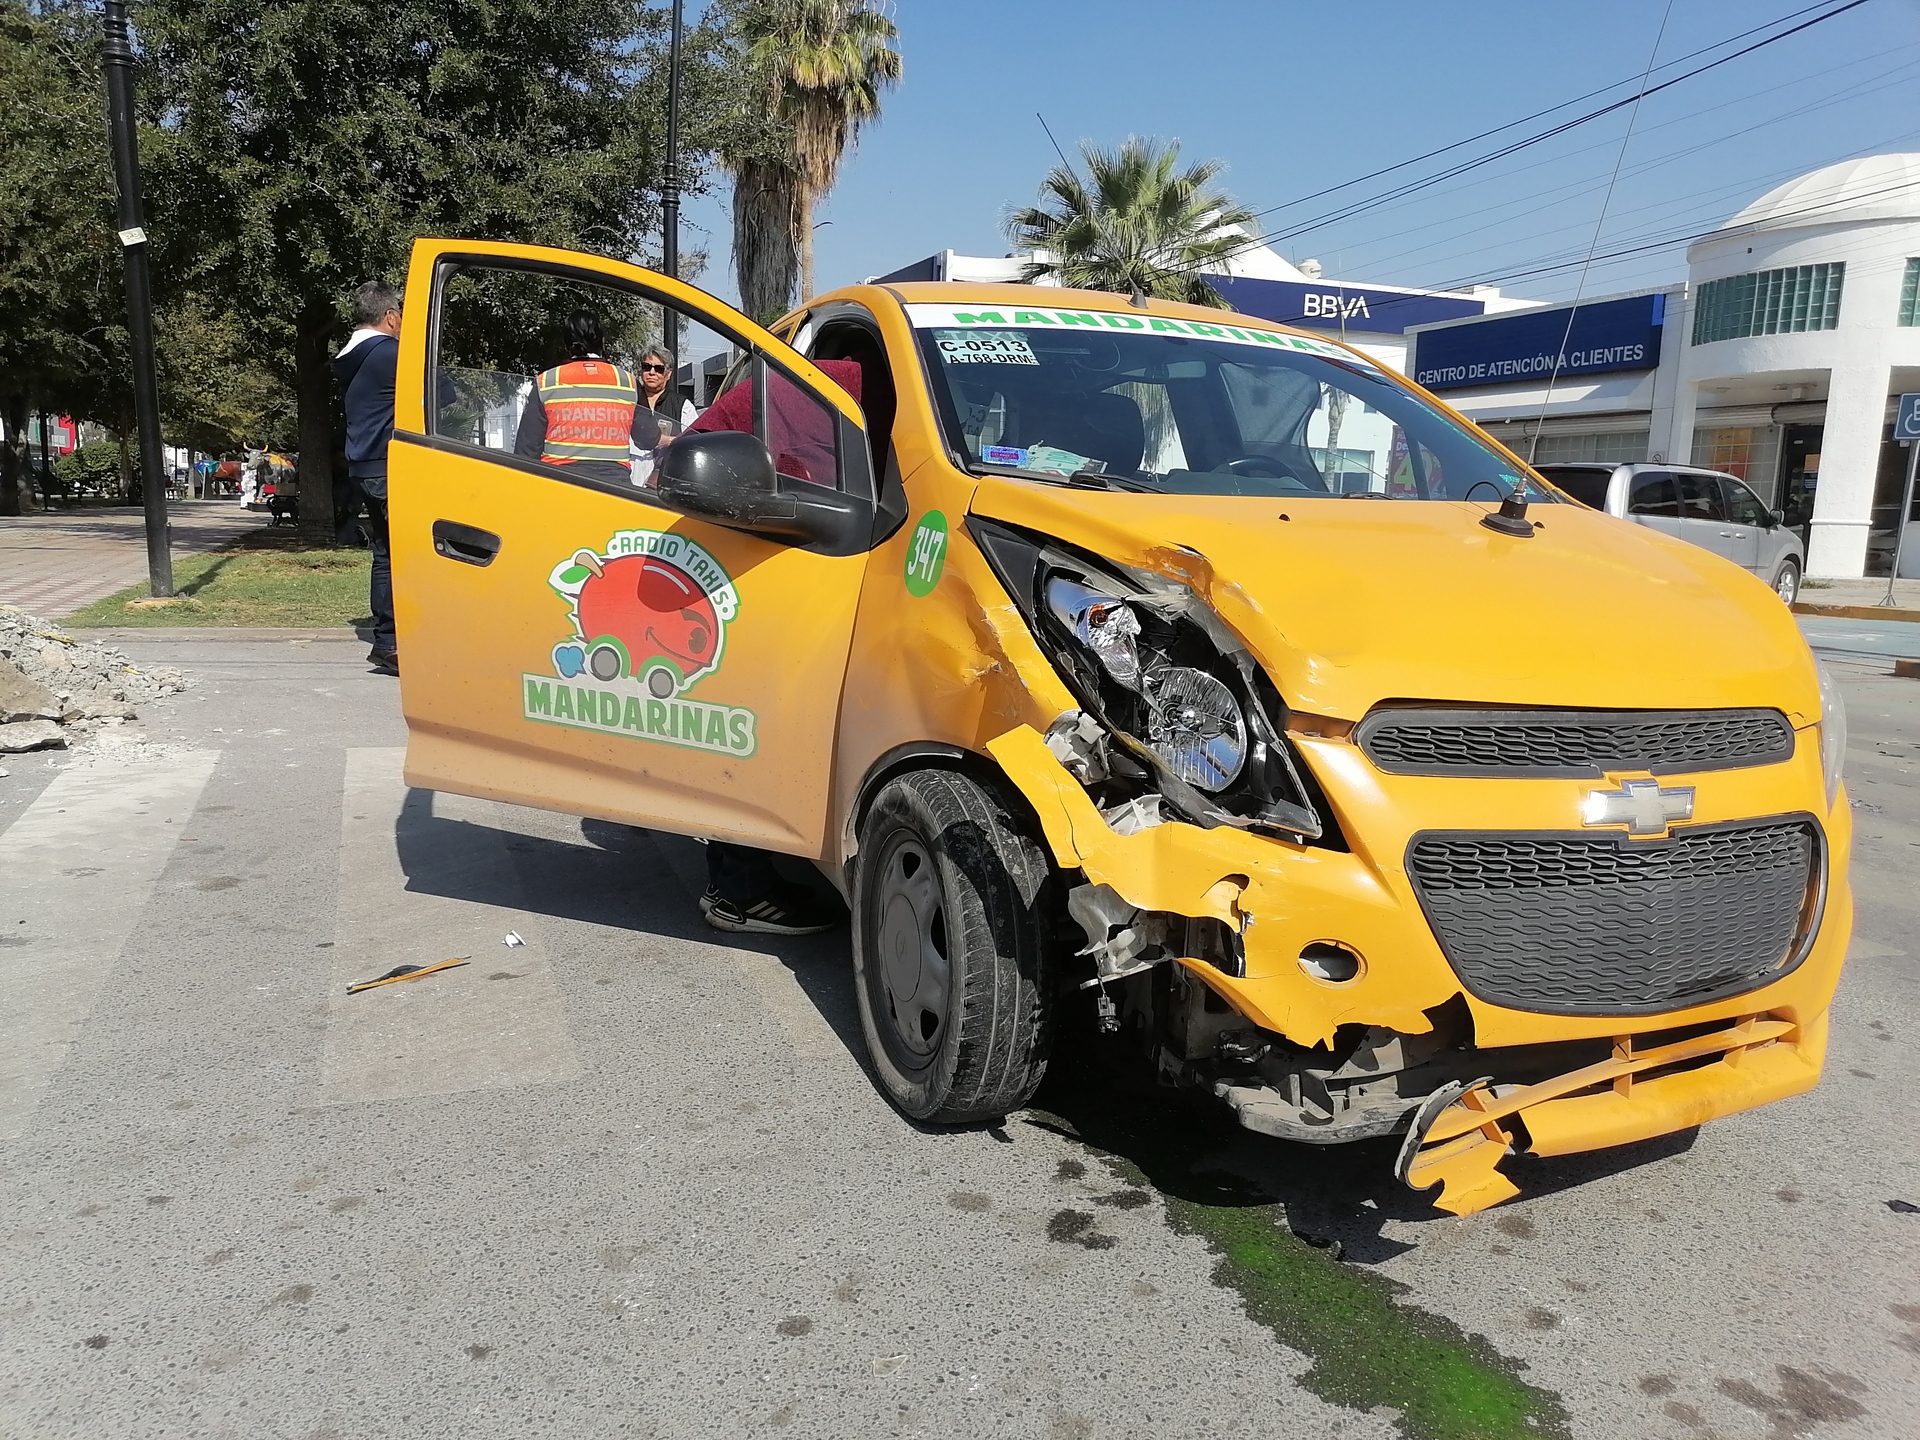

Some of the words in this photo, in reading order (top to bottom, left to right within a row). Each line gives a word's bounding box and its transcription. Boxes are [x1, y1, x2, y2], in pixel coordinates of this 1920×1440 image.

[1303, 293, 1370, 319] BBVA
[940, 340, 1028, 352] C-0513
[952, 312, 1354, 359] MANDARINAS
[1418, 365, 1466, 385] CENTRO
[1468, 363, 1486, 379] DE
[1488, 353, 1554, 377] ATENCIÓN
[1556, 352, 1568, 369] A
[1571, 344, 1644, 367] CLIENTES
[552, 407, 630, 423] TRANSITO
[620, 536, 679, 558] RADIO
[686, 549, 729, 607] TAXIS
[907, 525, 945, 582] 347
[527, 679, 750, 750] MANDARINAS
